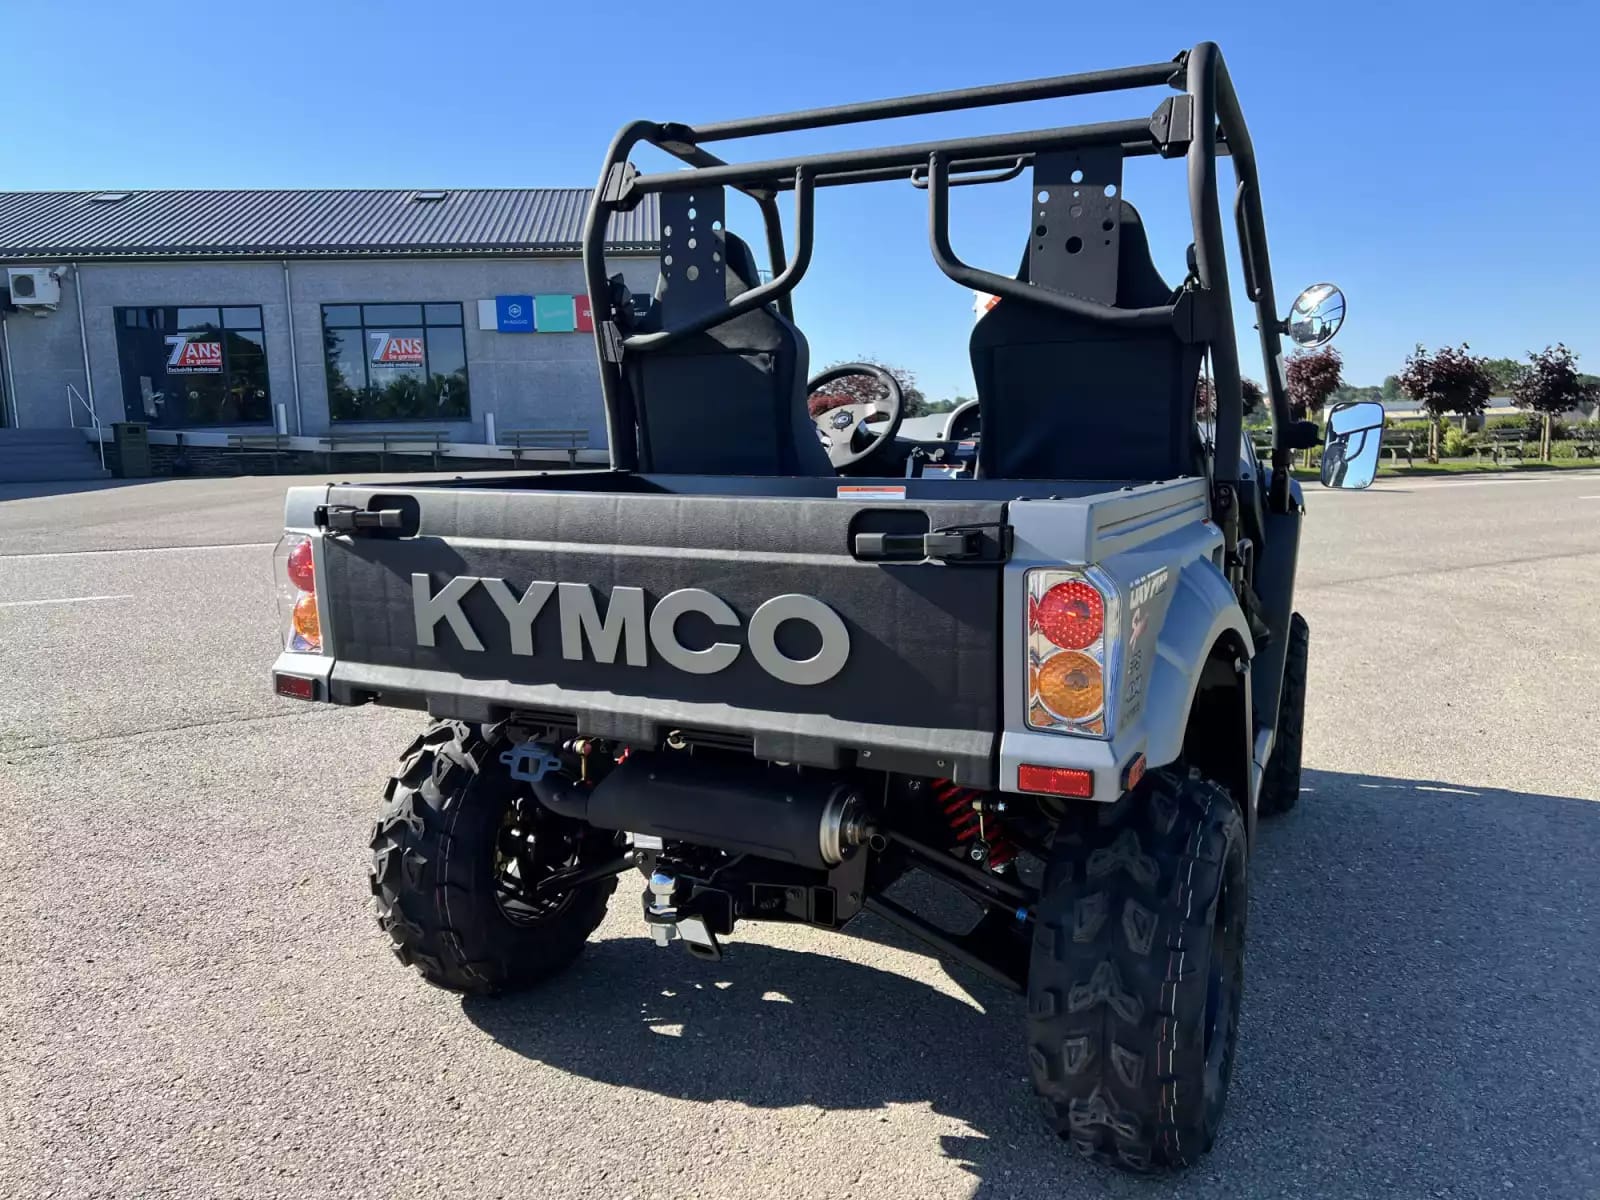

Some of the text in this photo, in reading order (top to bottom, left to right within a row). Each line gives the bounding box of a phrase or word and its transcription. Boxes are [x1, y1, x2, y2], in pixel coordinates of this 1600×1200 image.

[166, 336, 220, 365] 7 ANS
[371, 333, 421, 360] 7 ANS
[411, 573, 850, 686] KYMCO
